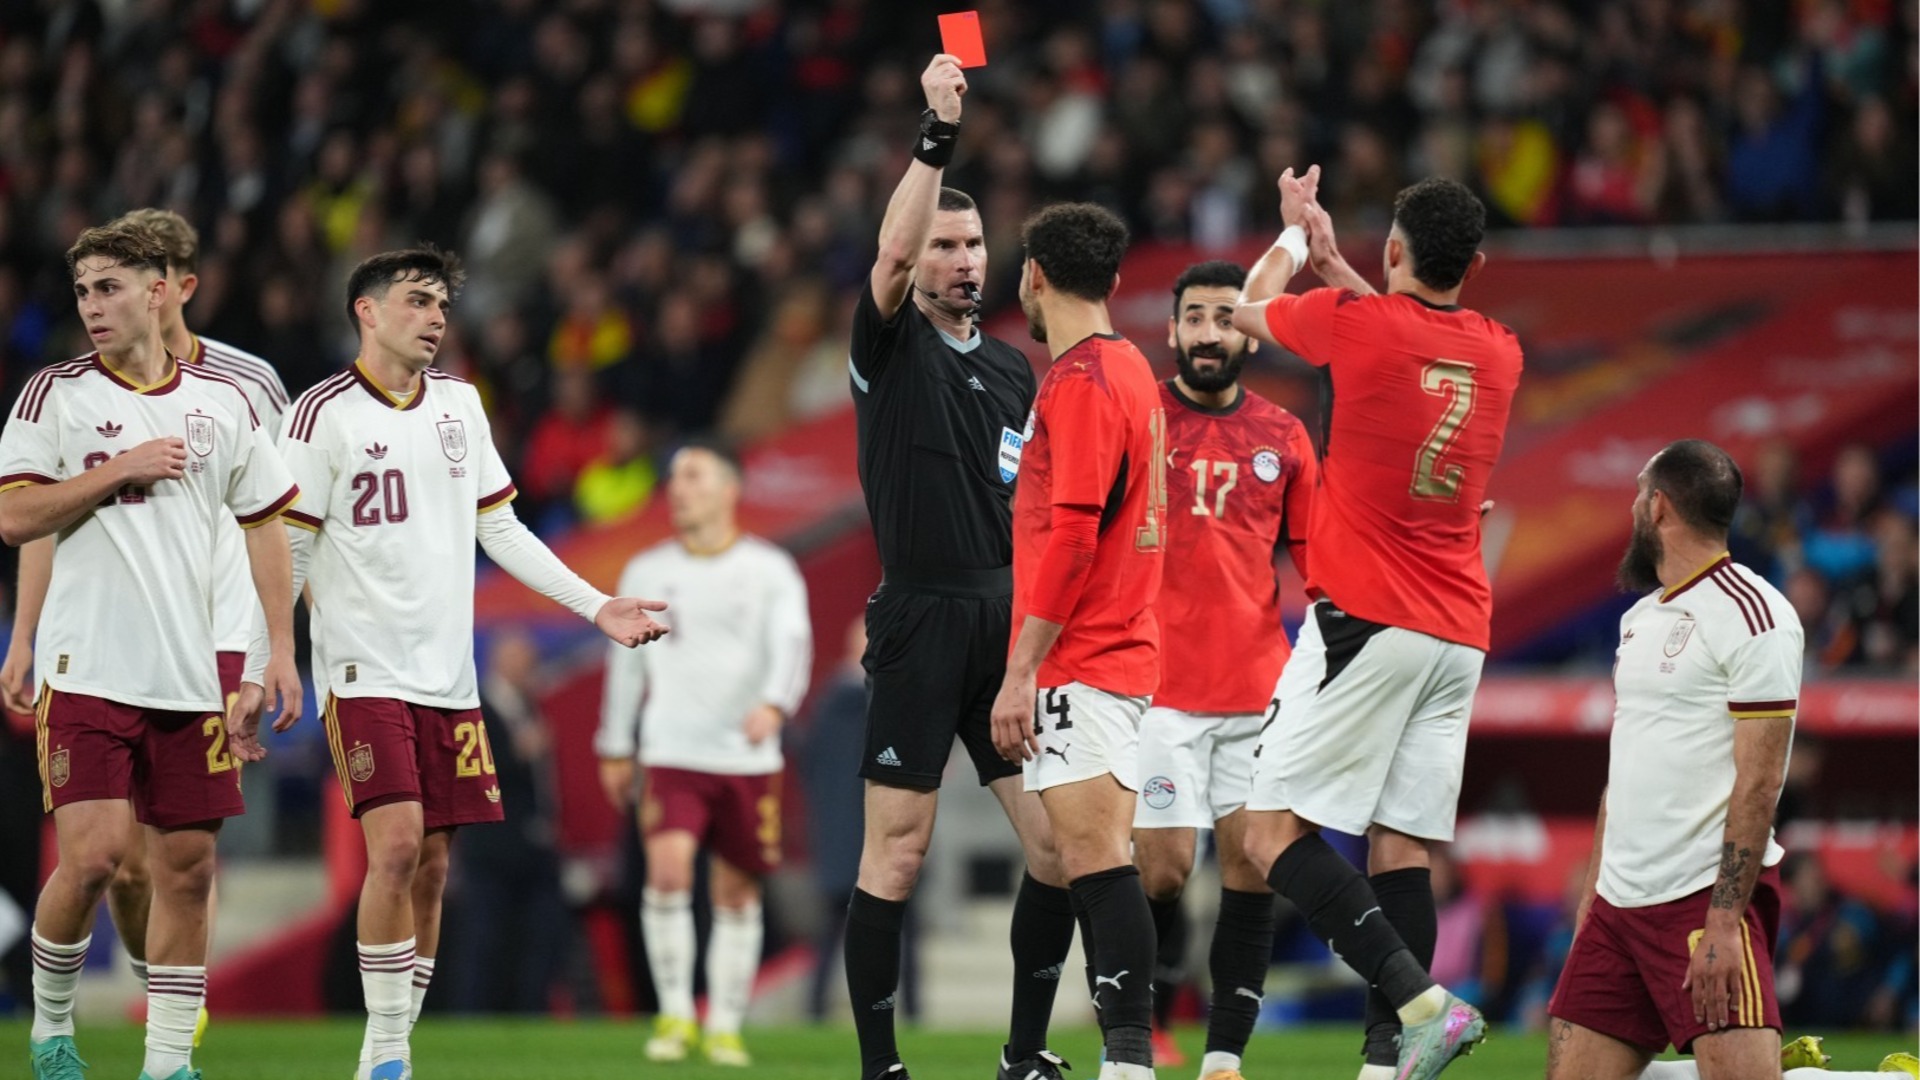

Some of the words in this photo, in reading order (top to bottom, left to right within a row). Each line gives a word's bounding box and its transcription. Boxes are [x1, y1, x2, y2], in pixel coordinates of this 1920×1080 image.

[1003, 431, 1021, 449] FIFA
[1409, 358, 1477, 504] 2
[352, 469, 408, 527] 20
[1191, 459, 1237, 518] 17
[454, 720, 496, 777] 20
